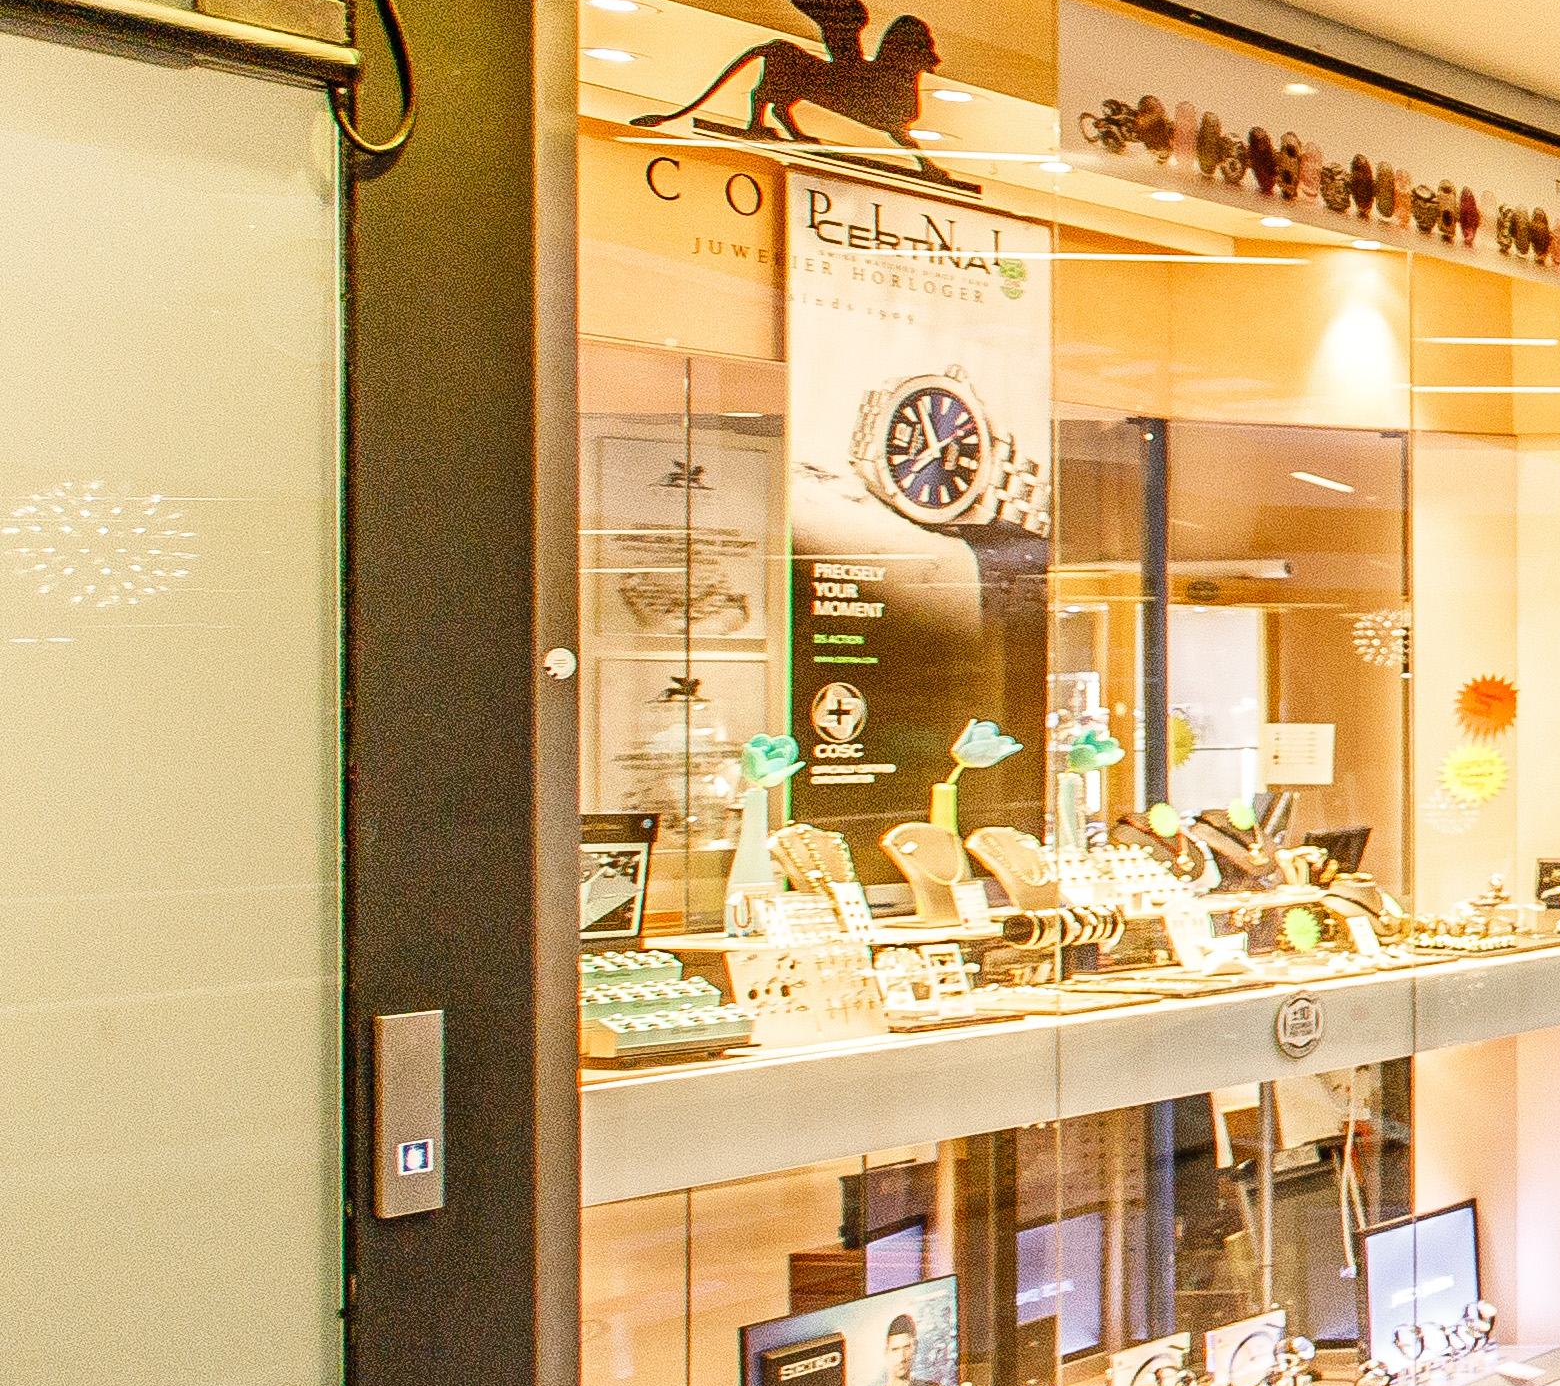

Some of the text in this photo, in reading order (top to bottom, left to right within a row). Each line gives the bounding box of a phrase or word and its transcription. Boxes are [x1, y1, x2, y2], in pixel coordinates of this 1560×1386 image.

[646, 156, 1003, 267] COPINI
[815, 219, 991, 275] CERTINA
[691, 237, 985, 304] JUWEIER HORLOGER
[812, 563, 886, 581] PRECISELY
[812, 582, 859, 598] YOUR
[812, 600, 886, 618] MOMENT
[812, 744, 865, 759] COSC
[780, 1352, 842, 1381] SEIKO
